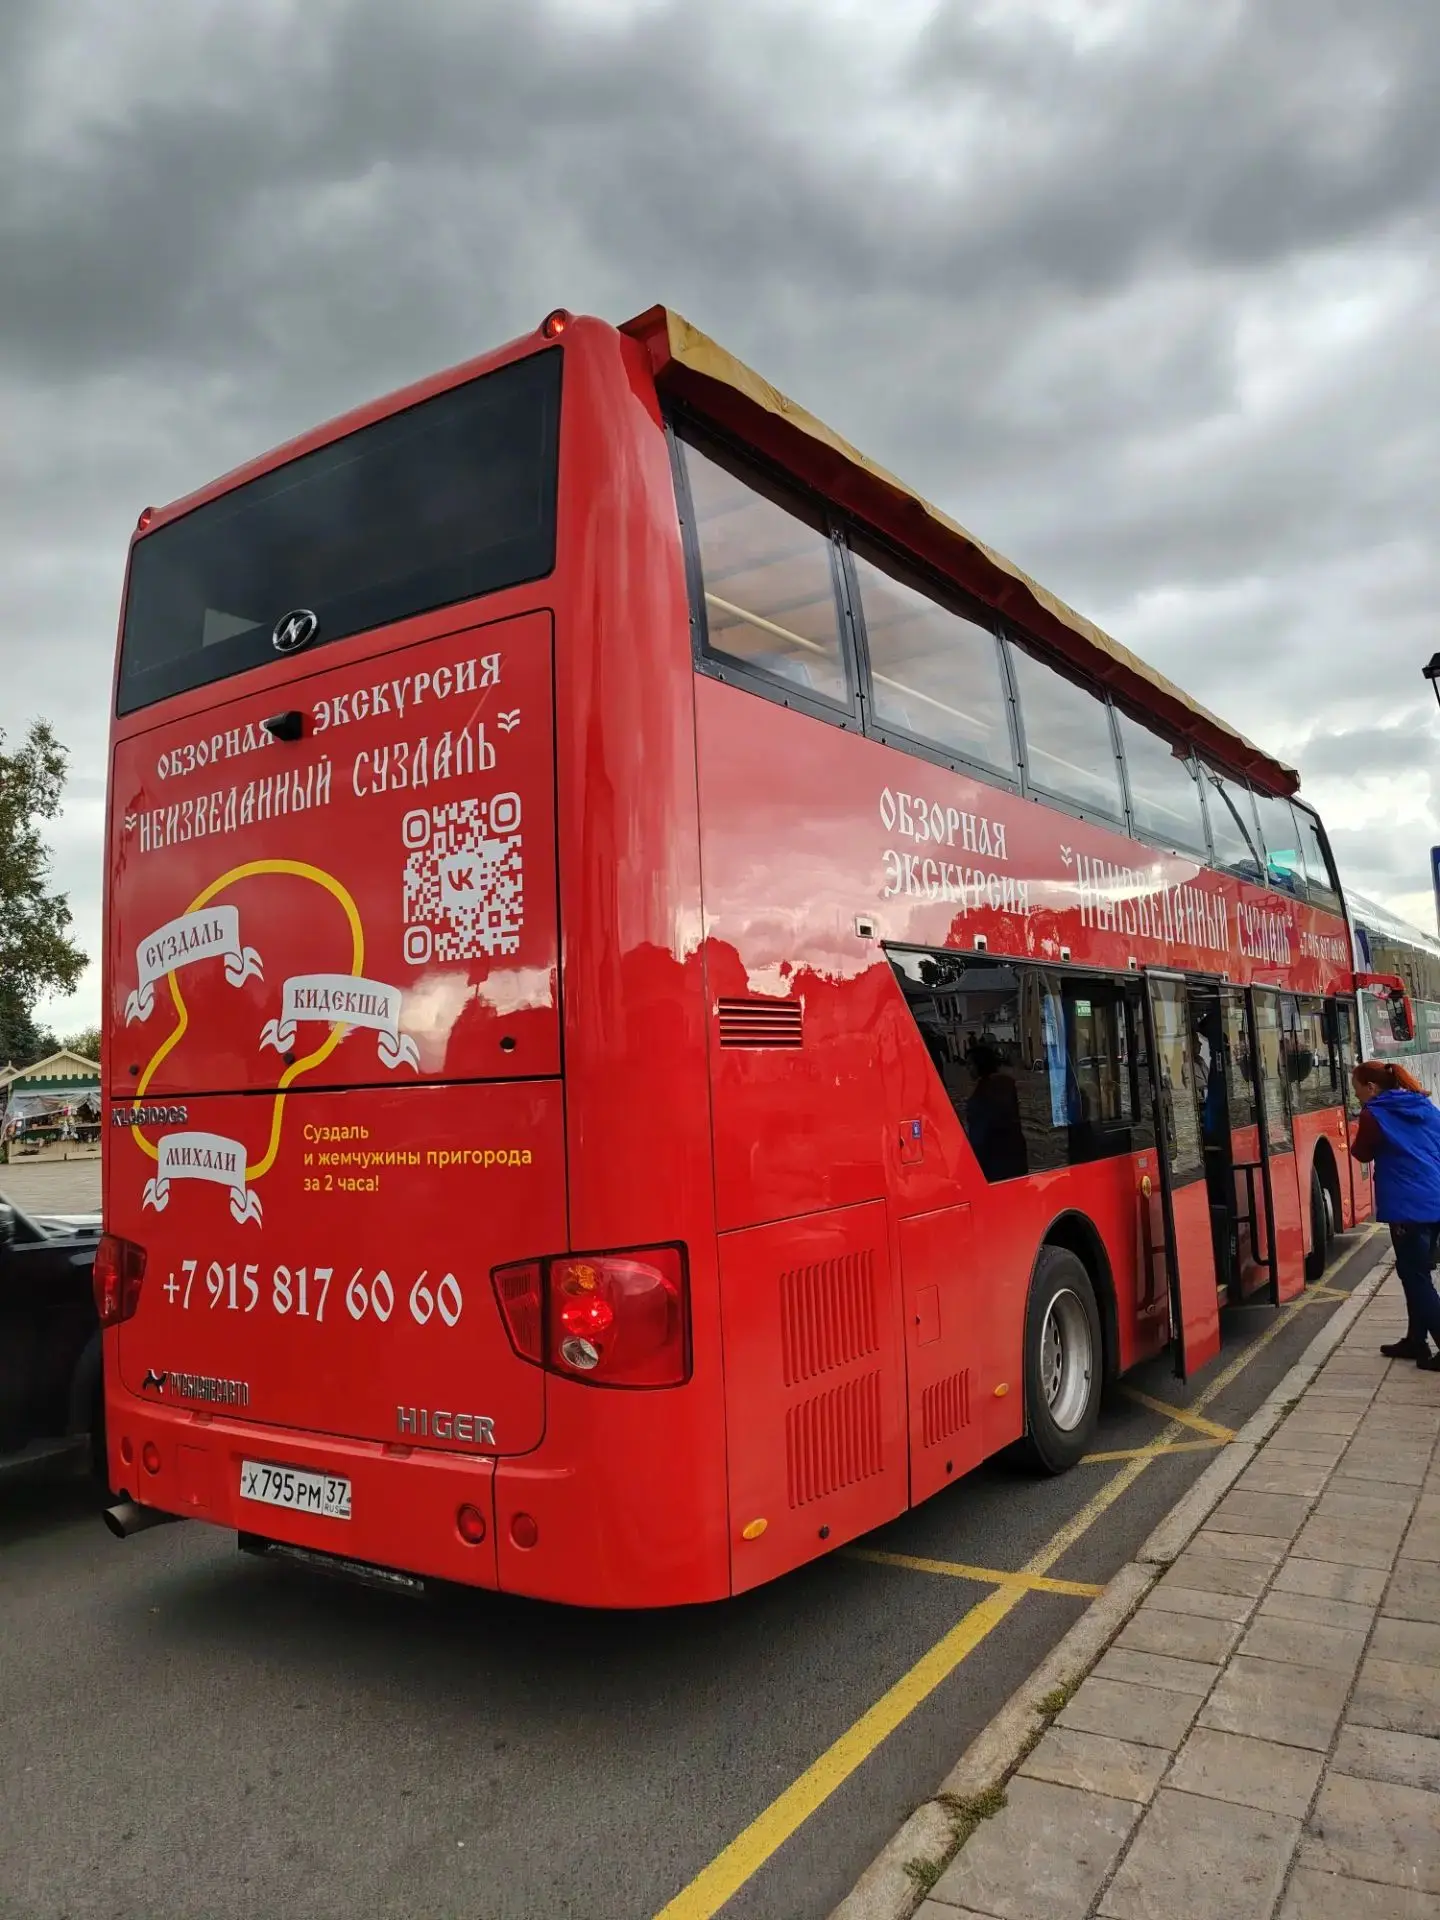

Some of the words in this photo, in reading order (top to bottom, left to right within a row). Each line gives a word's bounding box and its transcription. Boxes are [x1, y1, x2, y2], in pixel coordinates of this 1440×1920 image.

[157, 719, 275, 780] ОБЗОРНАЯ
[313, 652, 502, 736] ЭКСКУРСИЯ
[879, 785, 1009, 860] ОБЗОРНАЯ
[882, 849, 1030, 918] ЭКСКУРСИЯ
[145, 918, 225, 969] СУЗДАЛЬ
[293, 987, 391, 1019] КИДЕКША
[303, 1123, 369, 1142] Суздаль
[165, 1146, 237, 1173] МИХАЛИ
[303, 1152, 313, 1165] и
[318, 1150, 421, 1168] жемчужины
[426, 1149, 532, 1168] пригорода
[303, 1179, 321, 1192] за
[324, 1175, 333, 1191] 2
[337, 1174, 380, 1192] часа!
[163, 1260, 198, 1310] +7
[206, 1261, 260, 1313] 915
[272, 1264, 334, 1322] 817
[345, 1266, 395, 1323] 60
[409, 1270, 463, 1327] 60
[396, 1406, 497, 1446] HIGER
